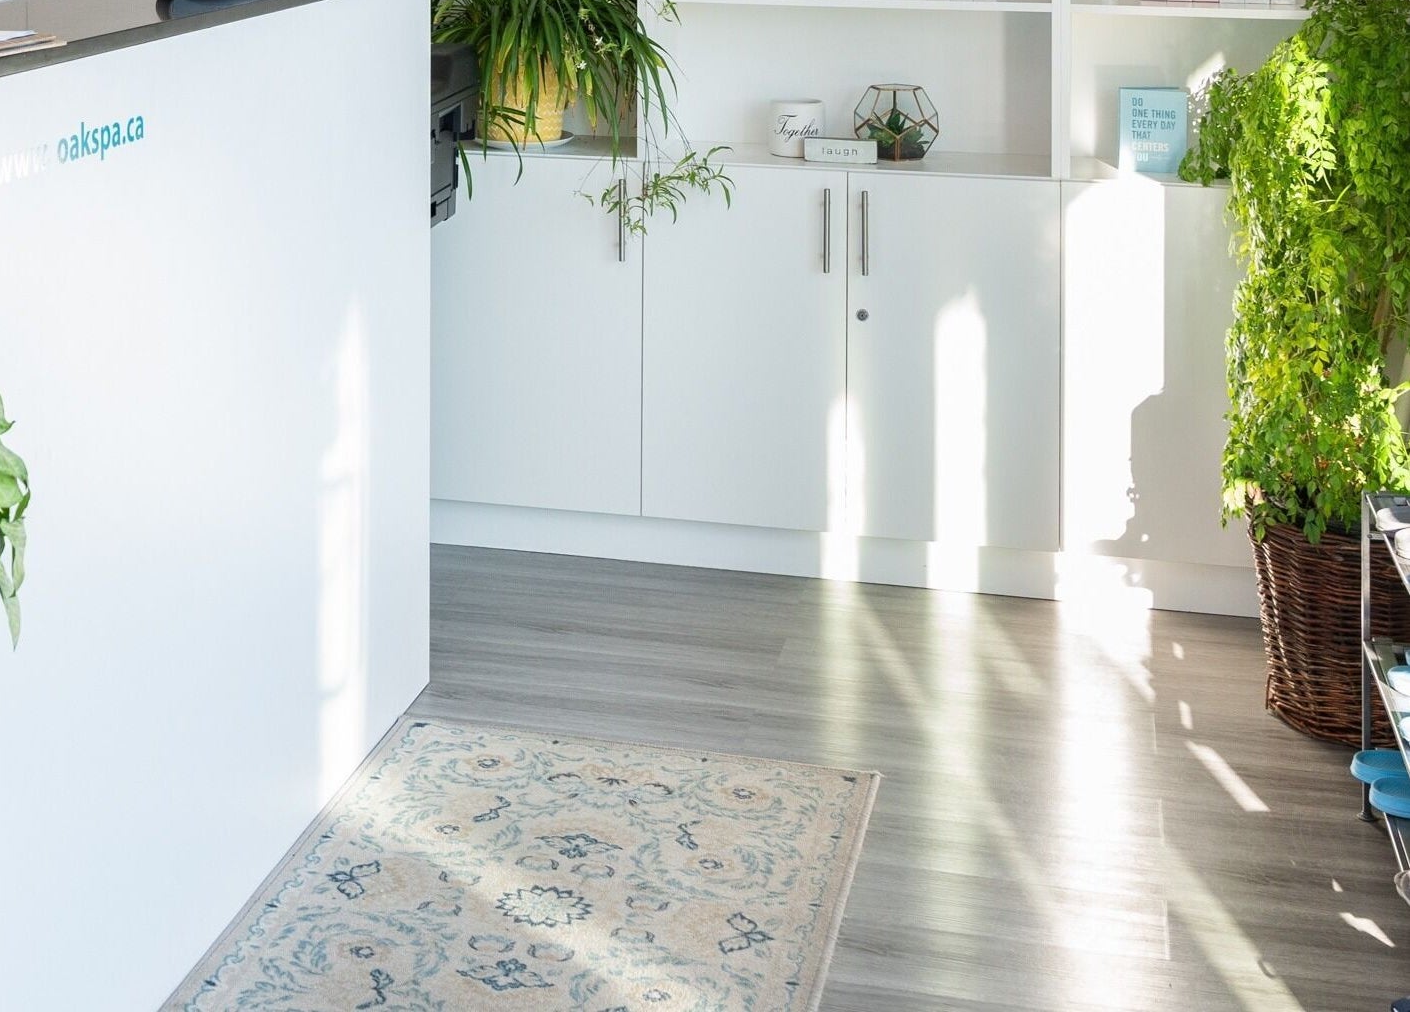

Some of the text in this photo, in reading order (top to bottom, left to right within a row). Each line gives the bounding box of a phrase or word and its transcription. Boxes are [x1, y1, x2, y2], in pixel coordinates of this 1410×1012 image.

[1131, 97, 1144, 107] DO
[1131, 108, 1177, 120] ONE THING
[774, 114, 820, 143] Together
[1131, 119, 1177, 131] EVERY DAY
[1131, 130, 1152, 140] THAT
[821, 147, 859, 157] laugh
[1131, 141, 1170, 153] CENTERS
